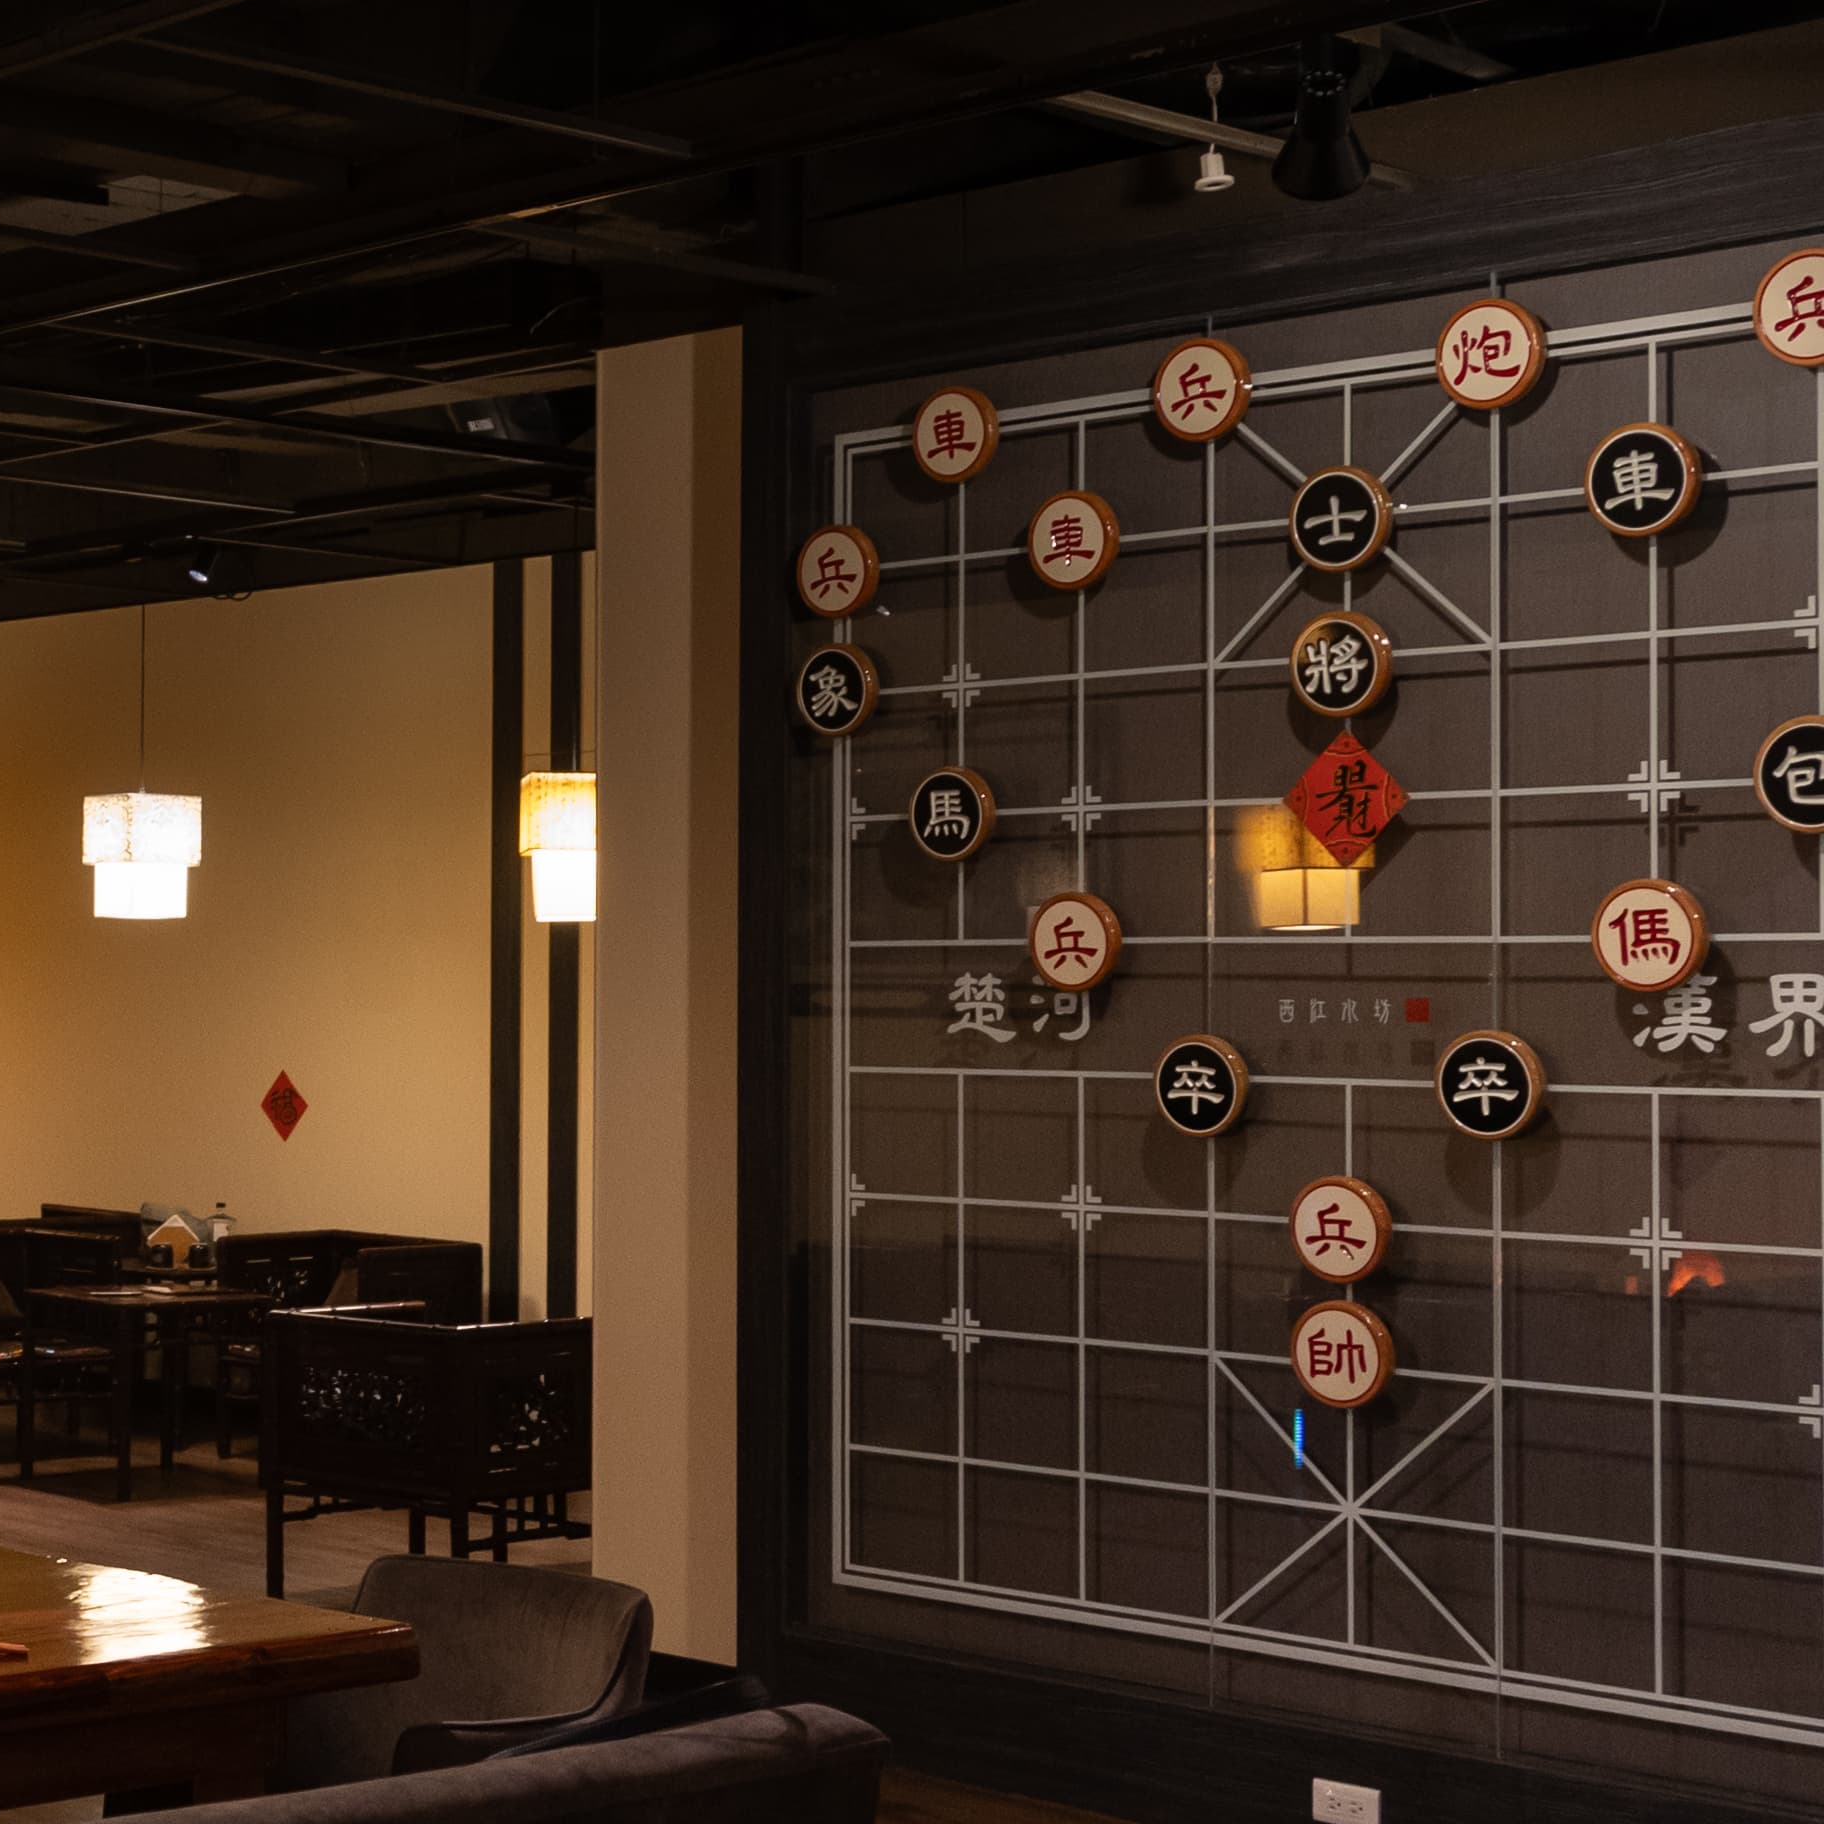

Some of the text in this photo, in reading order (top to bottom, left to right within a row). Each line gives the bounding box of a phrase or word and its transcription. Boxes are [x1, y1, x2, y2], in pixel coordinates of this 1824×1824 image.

[1774, 276, 1824, 342] 兵
[1453, 325, 1520, 386] 炮
[1171, 363, 1227, 420] 兵
[927, 409, 976, 459] 車
[1605, 450, 1674, 510] 車
[1042, 514, 1095, 567] 車
[1304, 496, 1366, 545] 士
[810, 548, 857, 598] 兵
[809, 665, 858, 717] 象
[1304, 635, 1368, 694] 將
[923, 790, 970, 840] 馬
[1044, 917, 1097, 969] 兵
[1609, 908, 1680, 967] 傌
[947, 971, 1091, 1043] 楚河
[1632, 973, 1824, 1057] 漢界
[1167, 1060, 1225, 1114] 卒
[1452, 1057, 1519, 1116] 卒
[1305, 1203, 1366, 1260] 兵
[1307, 1328, 1367, 1384] 帥
